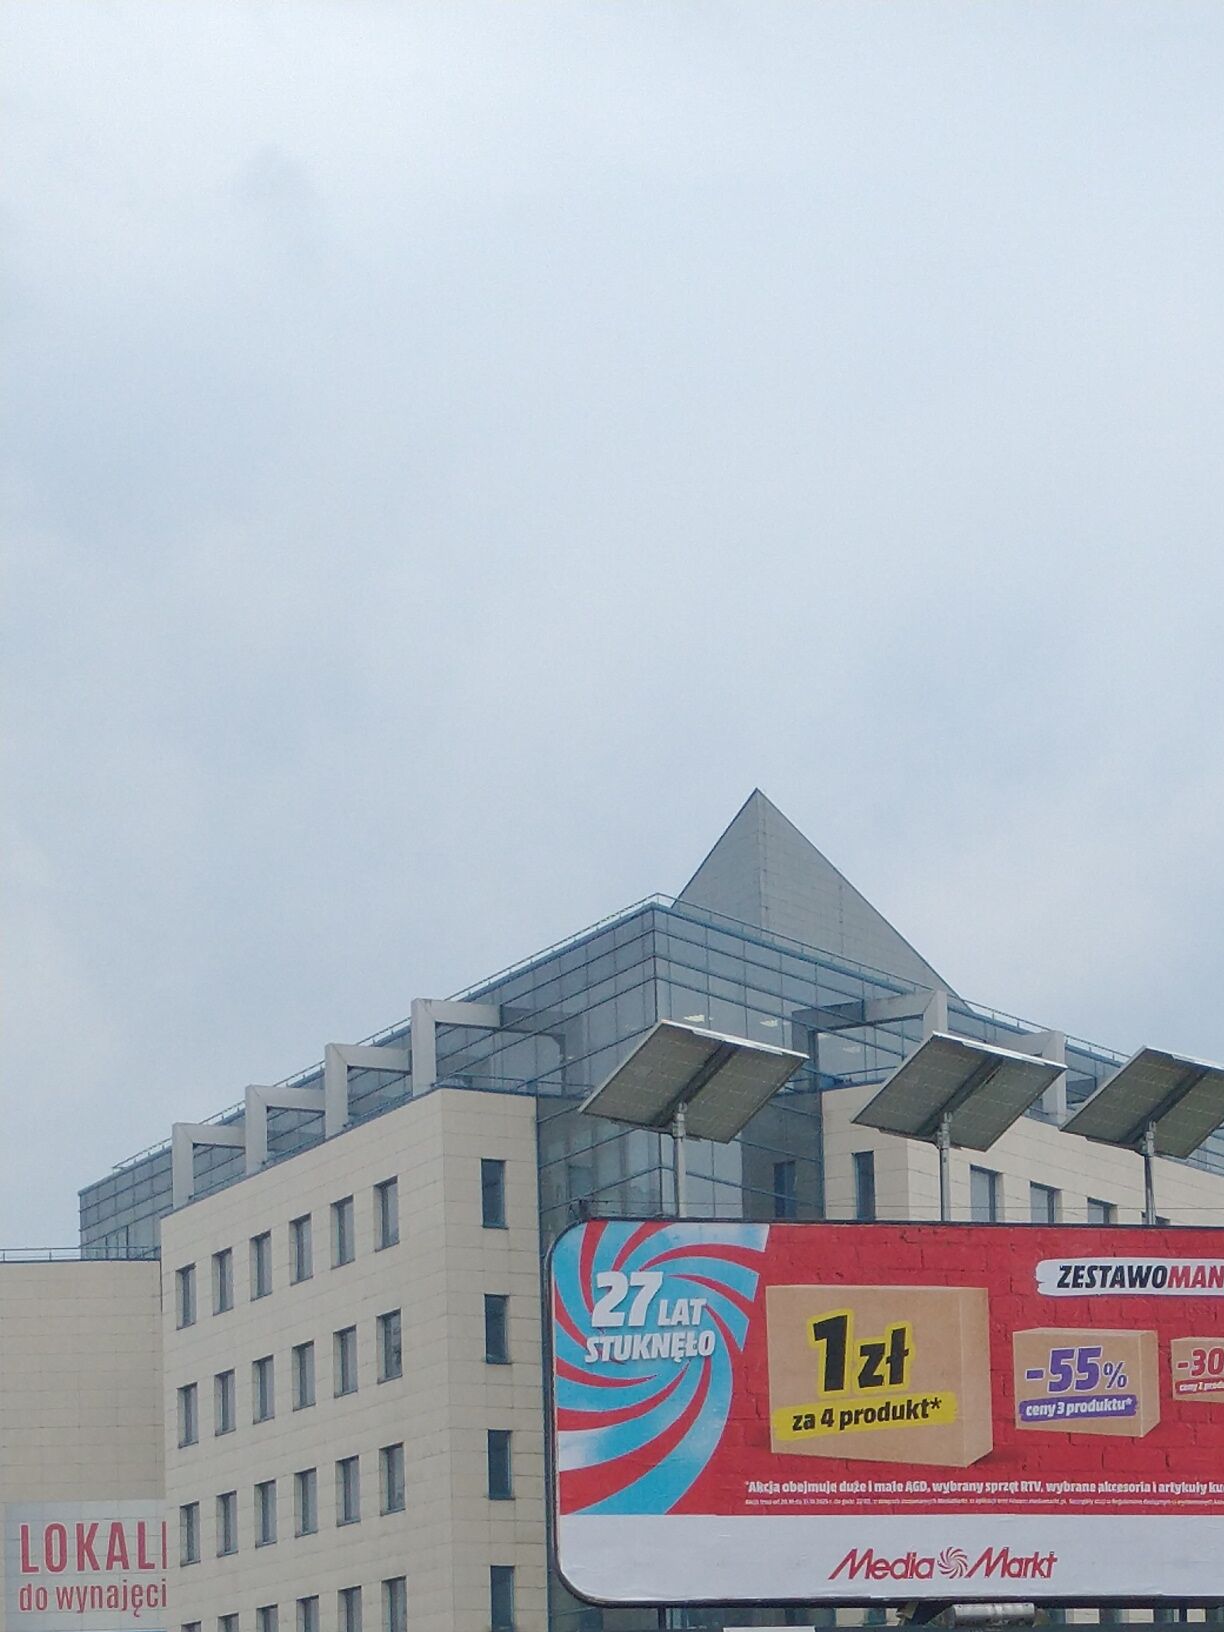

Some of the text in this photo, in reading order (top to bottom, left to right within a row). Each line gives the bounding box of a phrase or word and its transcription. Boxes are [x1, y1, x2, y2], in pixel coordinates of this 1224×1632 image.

[592, 1271, 707, 1327] 27 LAT
[584, 1330, 716, 1363] STUKNĘŁO
[813, 1315, 909, 1392] 1 zł
[1025, 1347, 1128, 1393] -55%
[792, 1414, 816, 1431] za
[820, 1408, 835, 1428] 4
[1026, 1402, 1055, 1418] ceny
[1056, 1402, 1065, 1415] 3
[839, 1480, 867, 1493] duże
[868, 1481, 872, 1493] i
[932, 1480, 984, 1494] wybrany
[985, 1480, 1020, 1495] sprzęt
[1045, 1480, 1096, 1495] wybrane
[1097, 1480, 1151, 1494] akcesoria
[1158, 1481, 1207, 1495] artykuły
[828, 1547, 1058, 1580] Media Markt
[19, 1578, 167, 1617] do wynajęci
